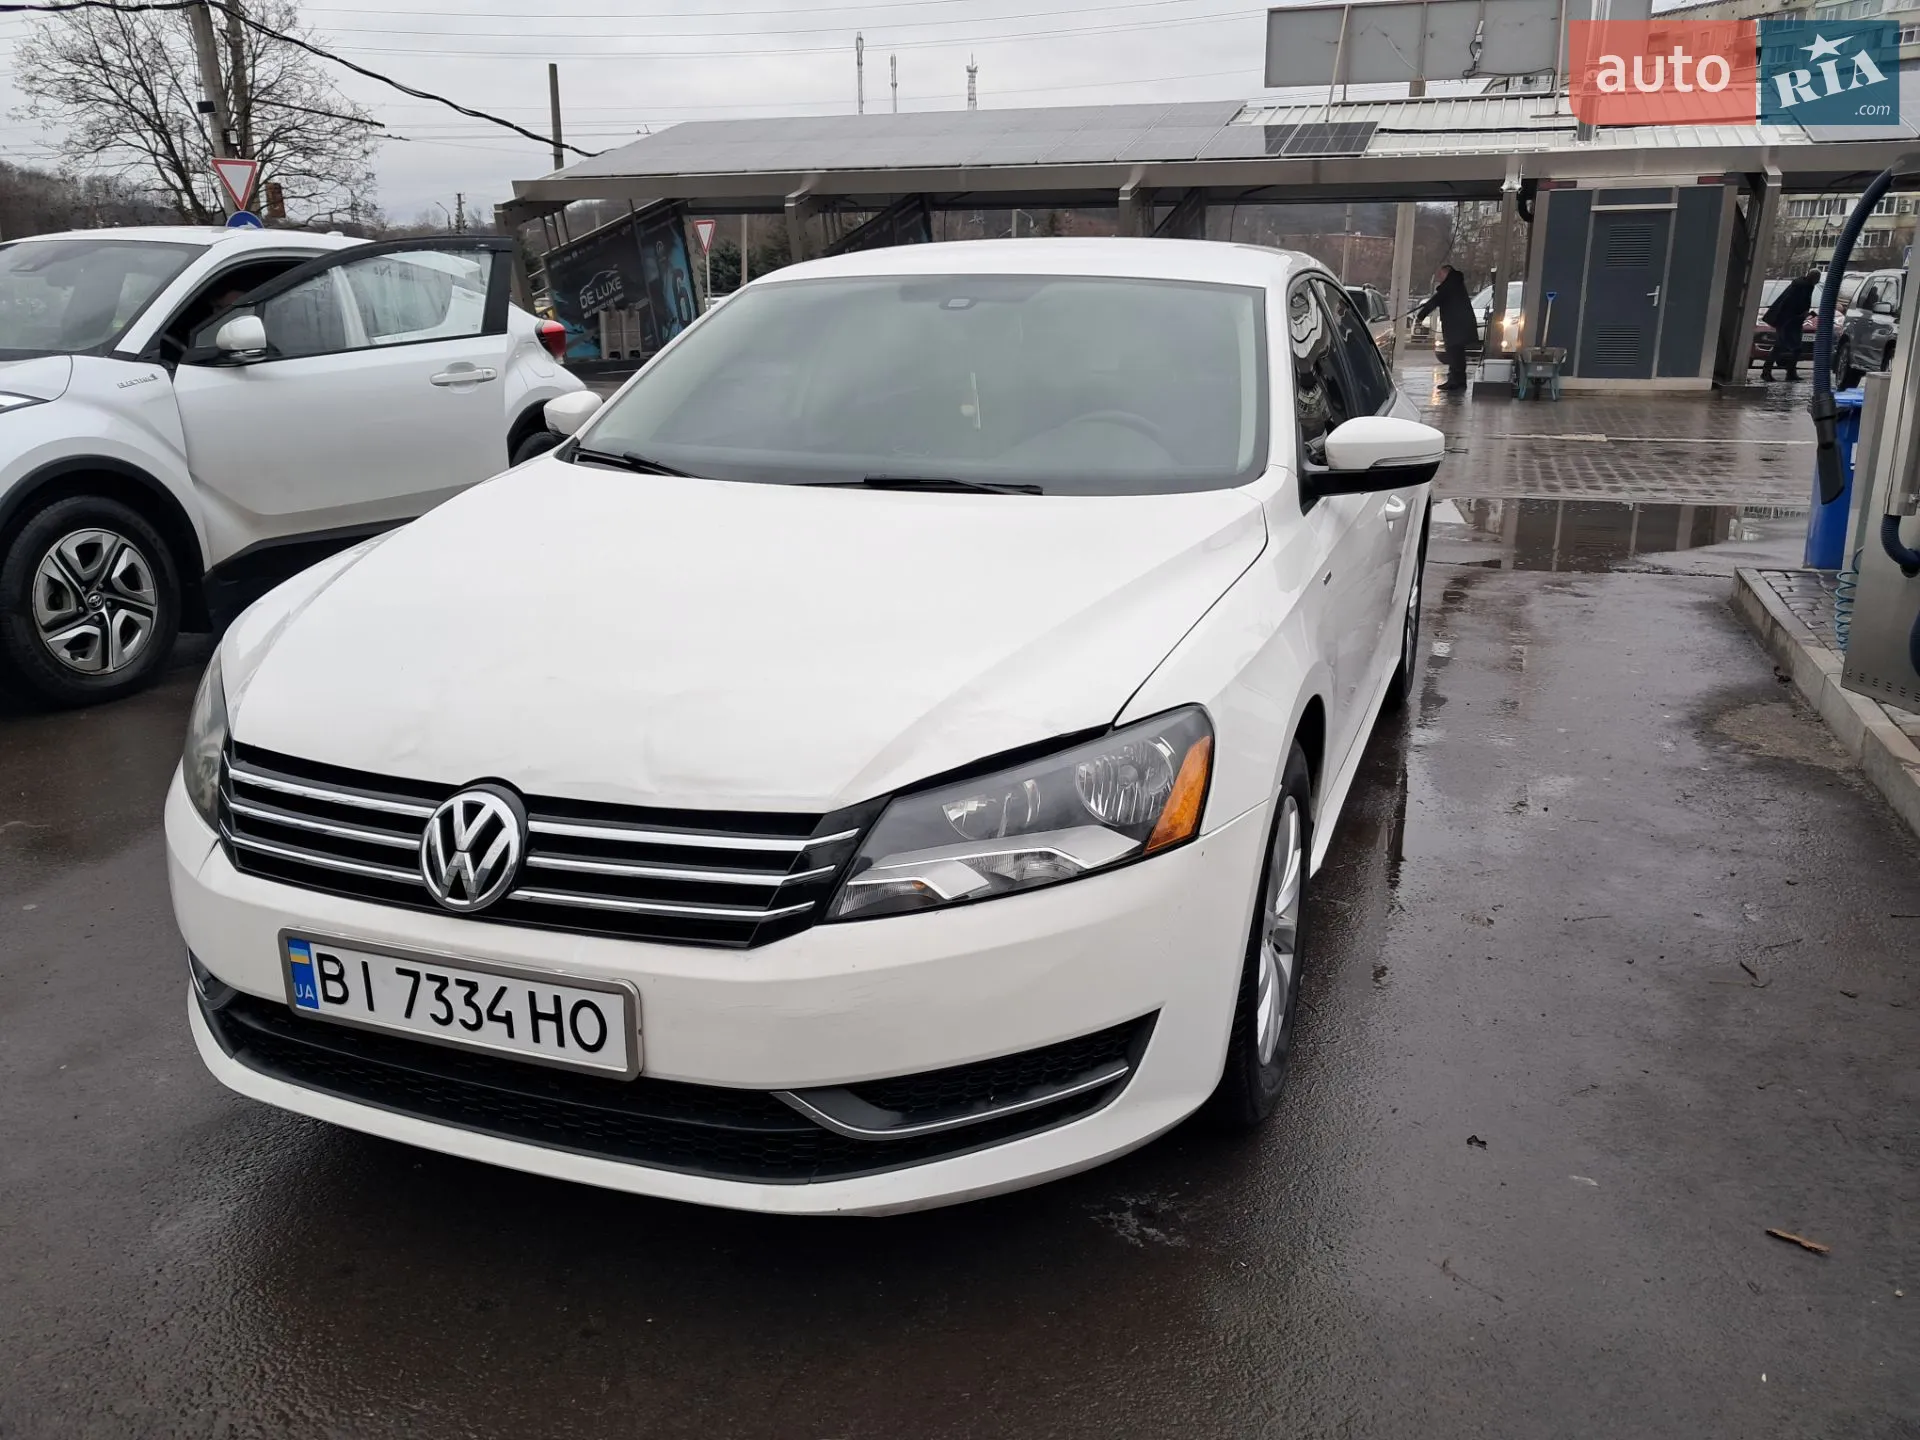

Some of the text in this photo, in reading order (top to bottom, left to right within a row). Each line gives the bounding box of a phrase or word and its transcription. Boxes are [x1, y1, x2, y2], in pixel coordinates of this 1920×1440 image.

[580, 276, 622, 309] DE LUXE
[672, 268, 691, 324] 6
[295, 982, 316, 1001] UA
[316, 952, 608, 1053] BI 7334 HO
